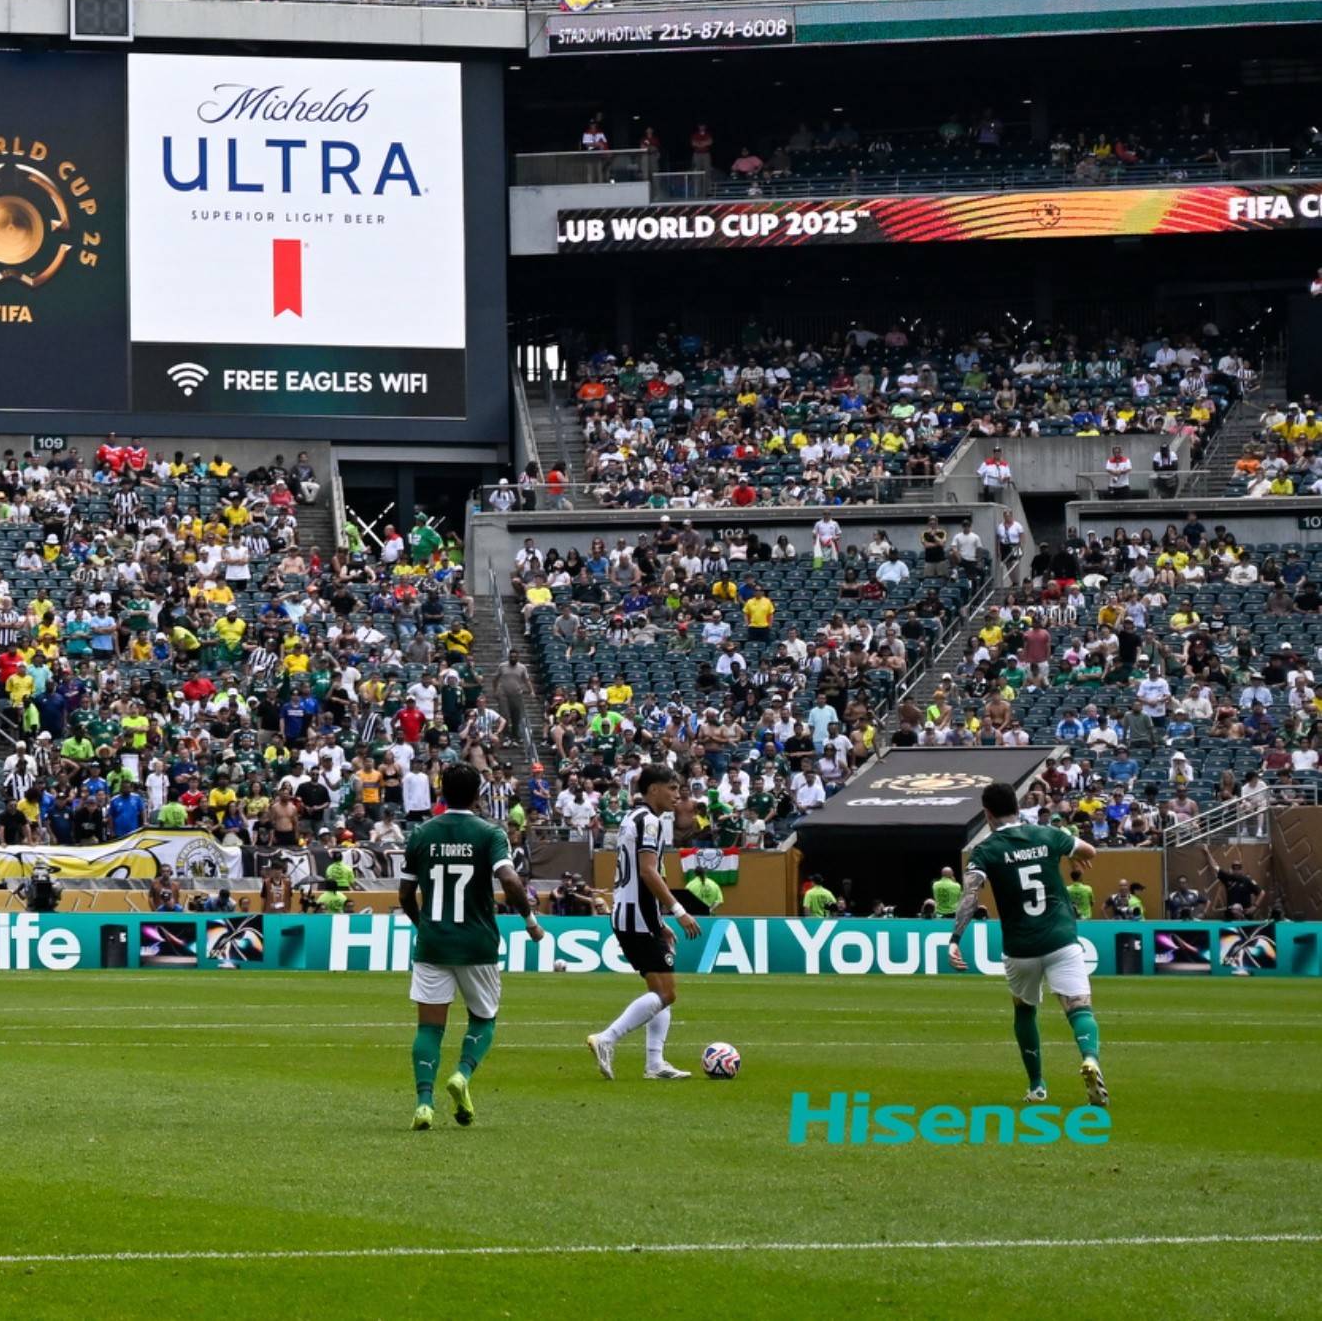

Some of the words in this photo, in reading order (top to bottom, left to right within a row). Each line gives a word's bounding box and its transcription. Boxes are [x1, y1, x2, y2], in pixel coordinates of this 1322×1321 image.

[659, 19, 787, 42] 215-874-6008
[197, 83, 376, 124] Michelob
[162, 136, 422, 196] ULTRA
[58, 160, 98, 215] CUP
[79, 231, 101, 268] 25
[191, 209, 275, 222] SUPERIOR
[285, 211, 334, 223] LIGHT
[344, 213, 386, 225] BEER
[1228, 194, 1294, 219] FIFA
[610, 215, 715, 242] WORLD
[721, 213, 780, 239] CUP
[223, 370, 278, 391] FREE
[285, 370, 372, 393] EAGLES
[380, 372, 428, 394] WIFI
[37, 437, 63, 449] 109
[429, 864, 474, 923] 17
[1018, 864, 1047, 916] 5
[696, 919, 768, 975] AI
[784, 919, 953, 975] Your
